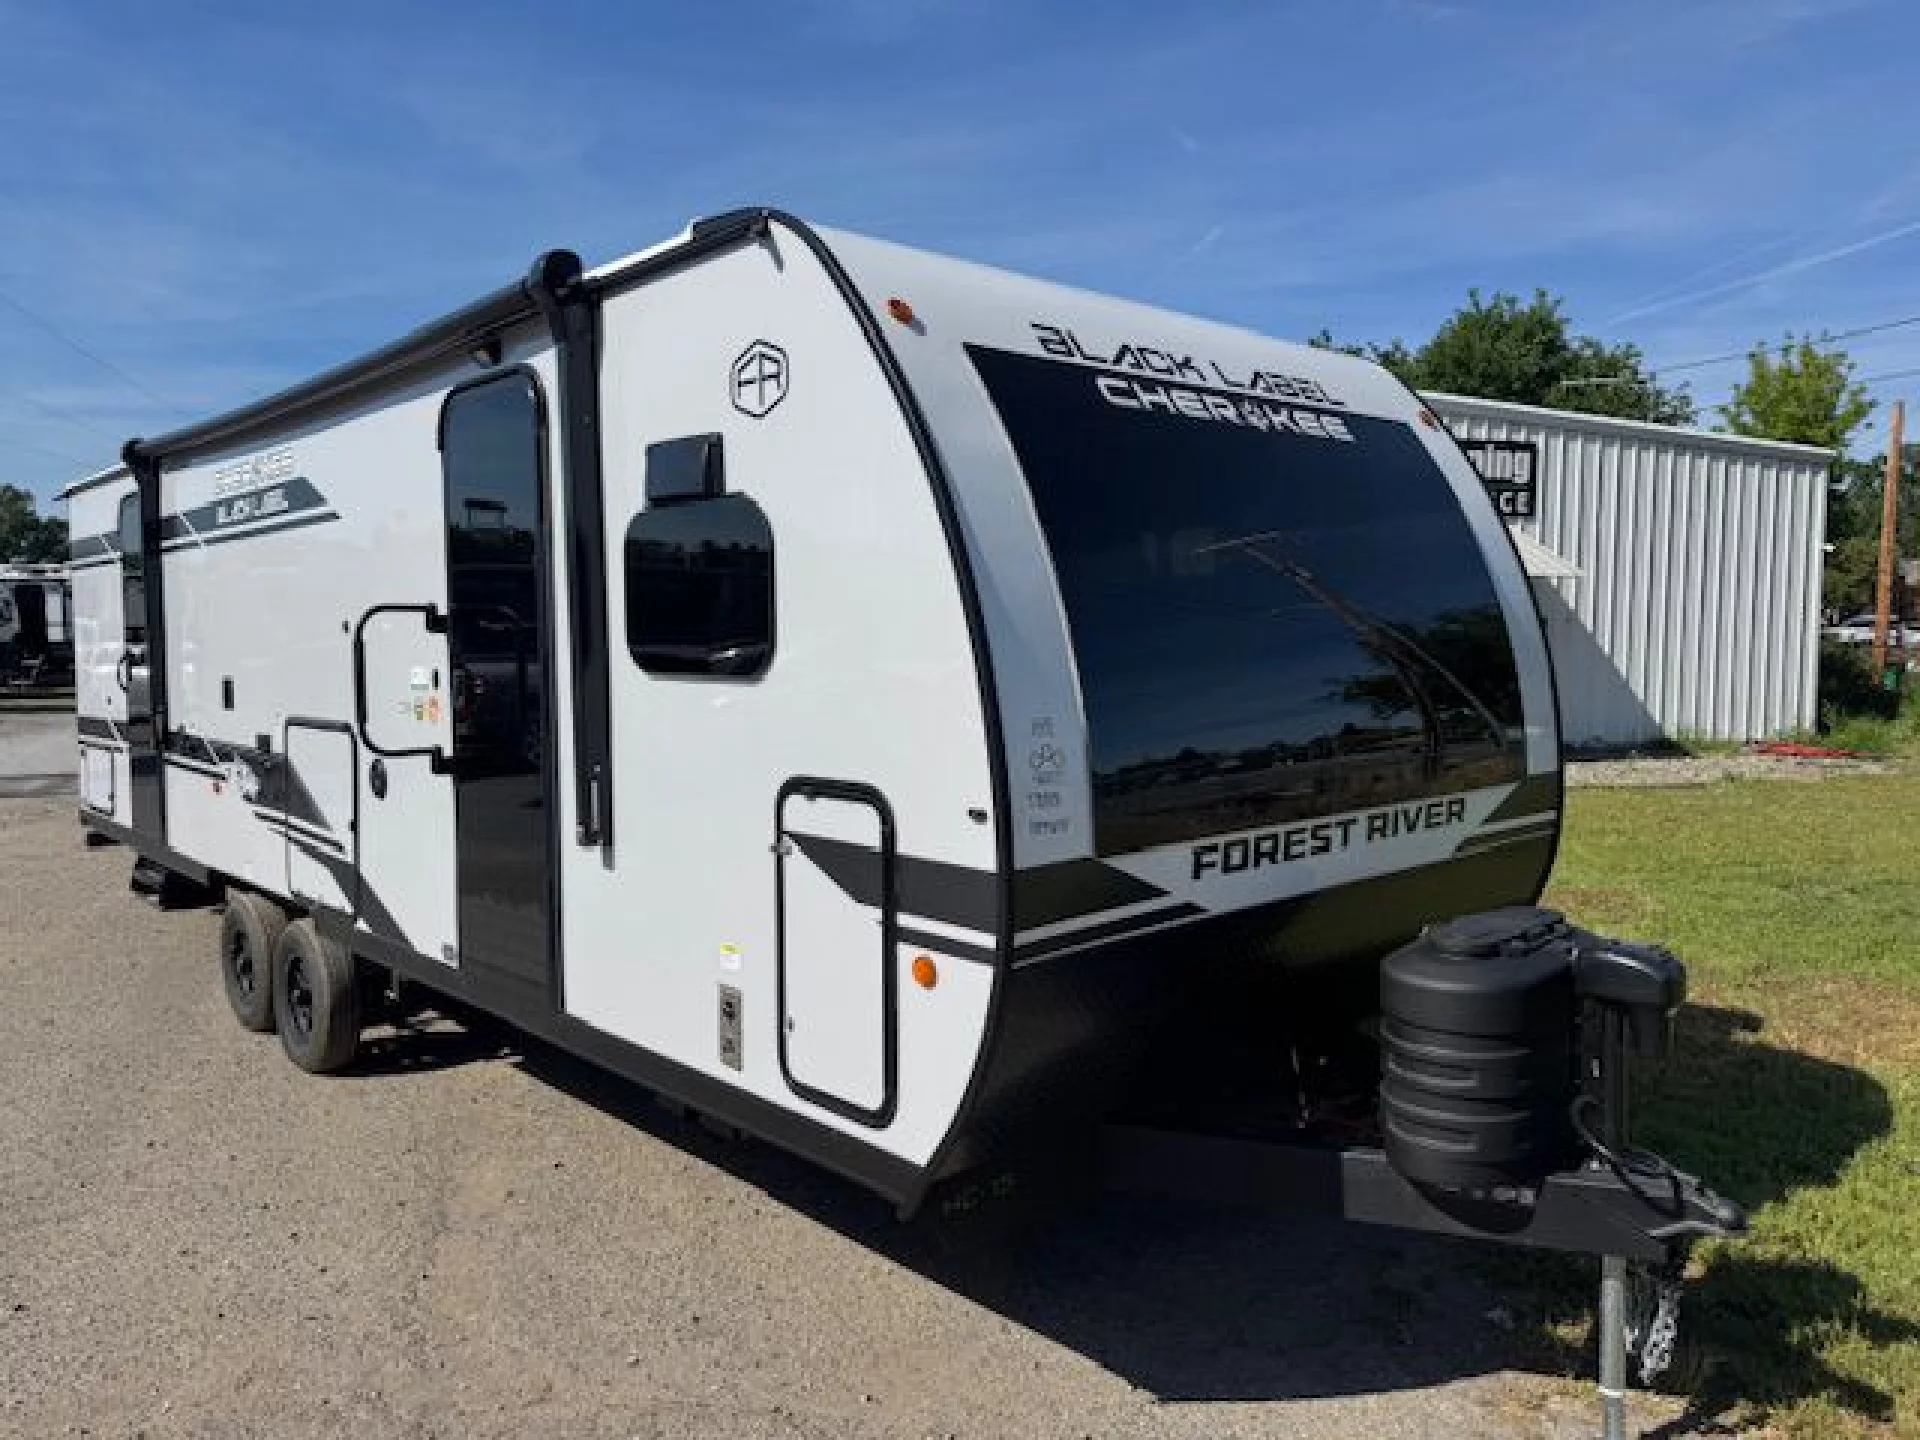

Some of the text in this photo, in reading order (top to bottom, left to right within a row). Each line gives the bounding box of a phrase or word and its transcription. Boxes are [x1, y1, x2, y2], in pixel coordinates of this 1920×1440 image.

[1030, 323, 1345, 407] BLACK LABEL
[1095, 376, 1355, 442] CHEROKEE
[1191, 797, 1466, 880] FOREST RIVER
